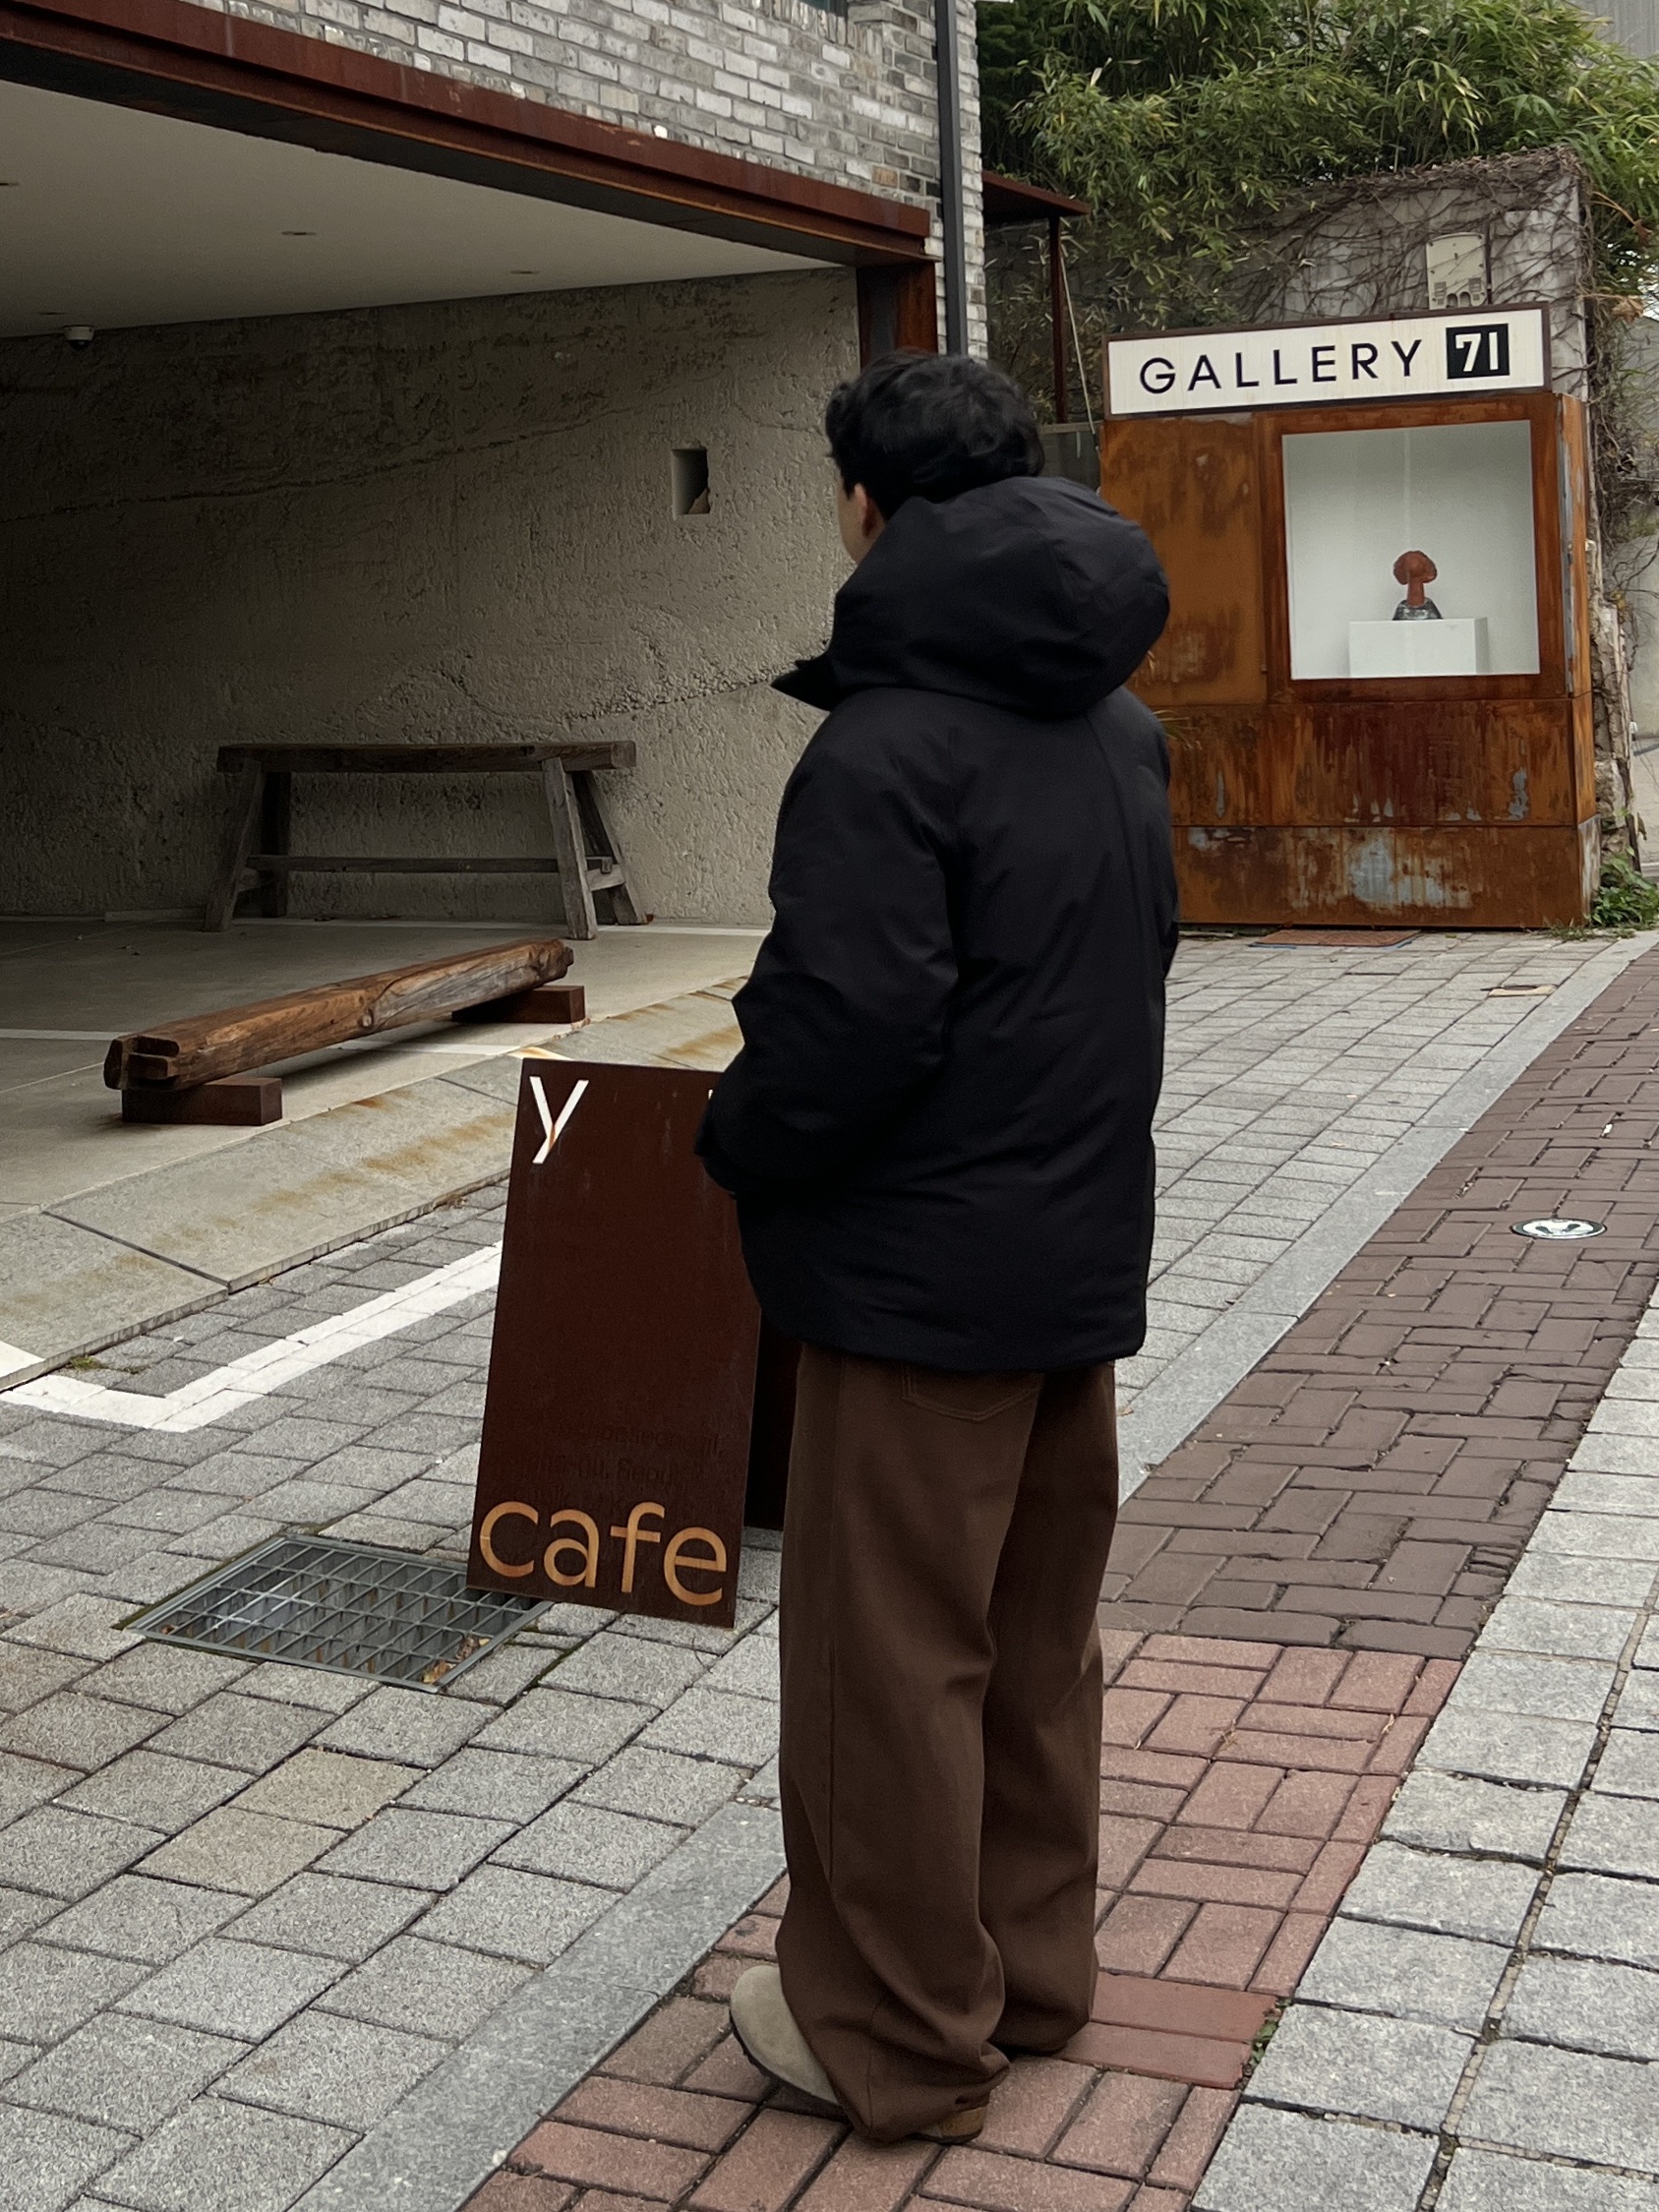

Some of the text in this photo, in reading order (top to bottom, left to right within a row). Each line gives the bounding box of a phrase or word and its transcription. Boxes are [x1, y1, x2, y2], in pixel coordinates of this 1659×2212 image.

[1140, 331, 1500, 394] GALLERY 71
[479, 1501, 727, 1606] cafe
